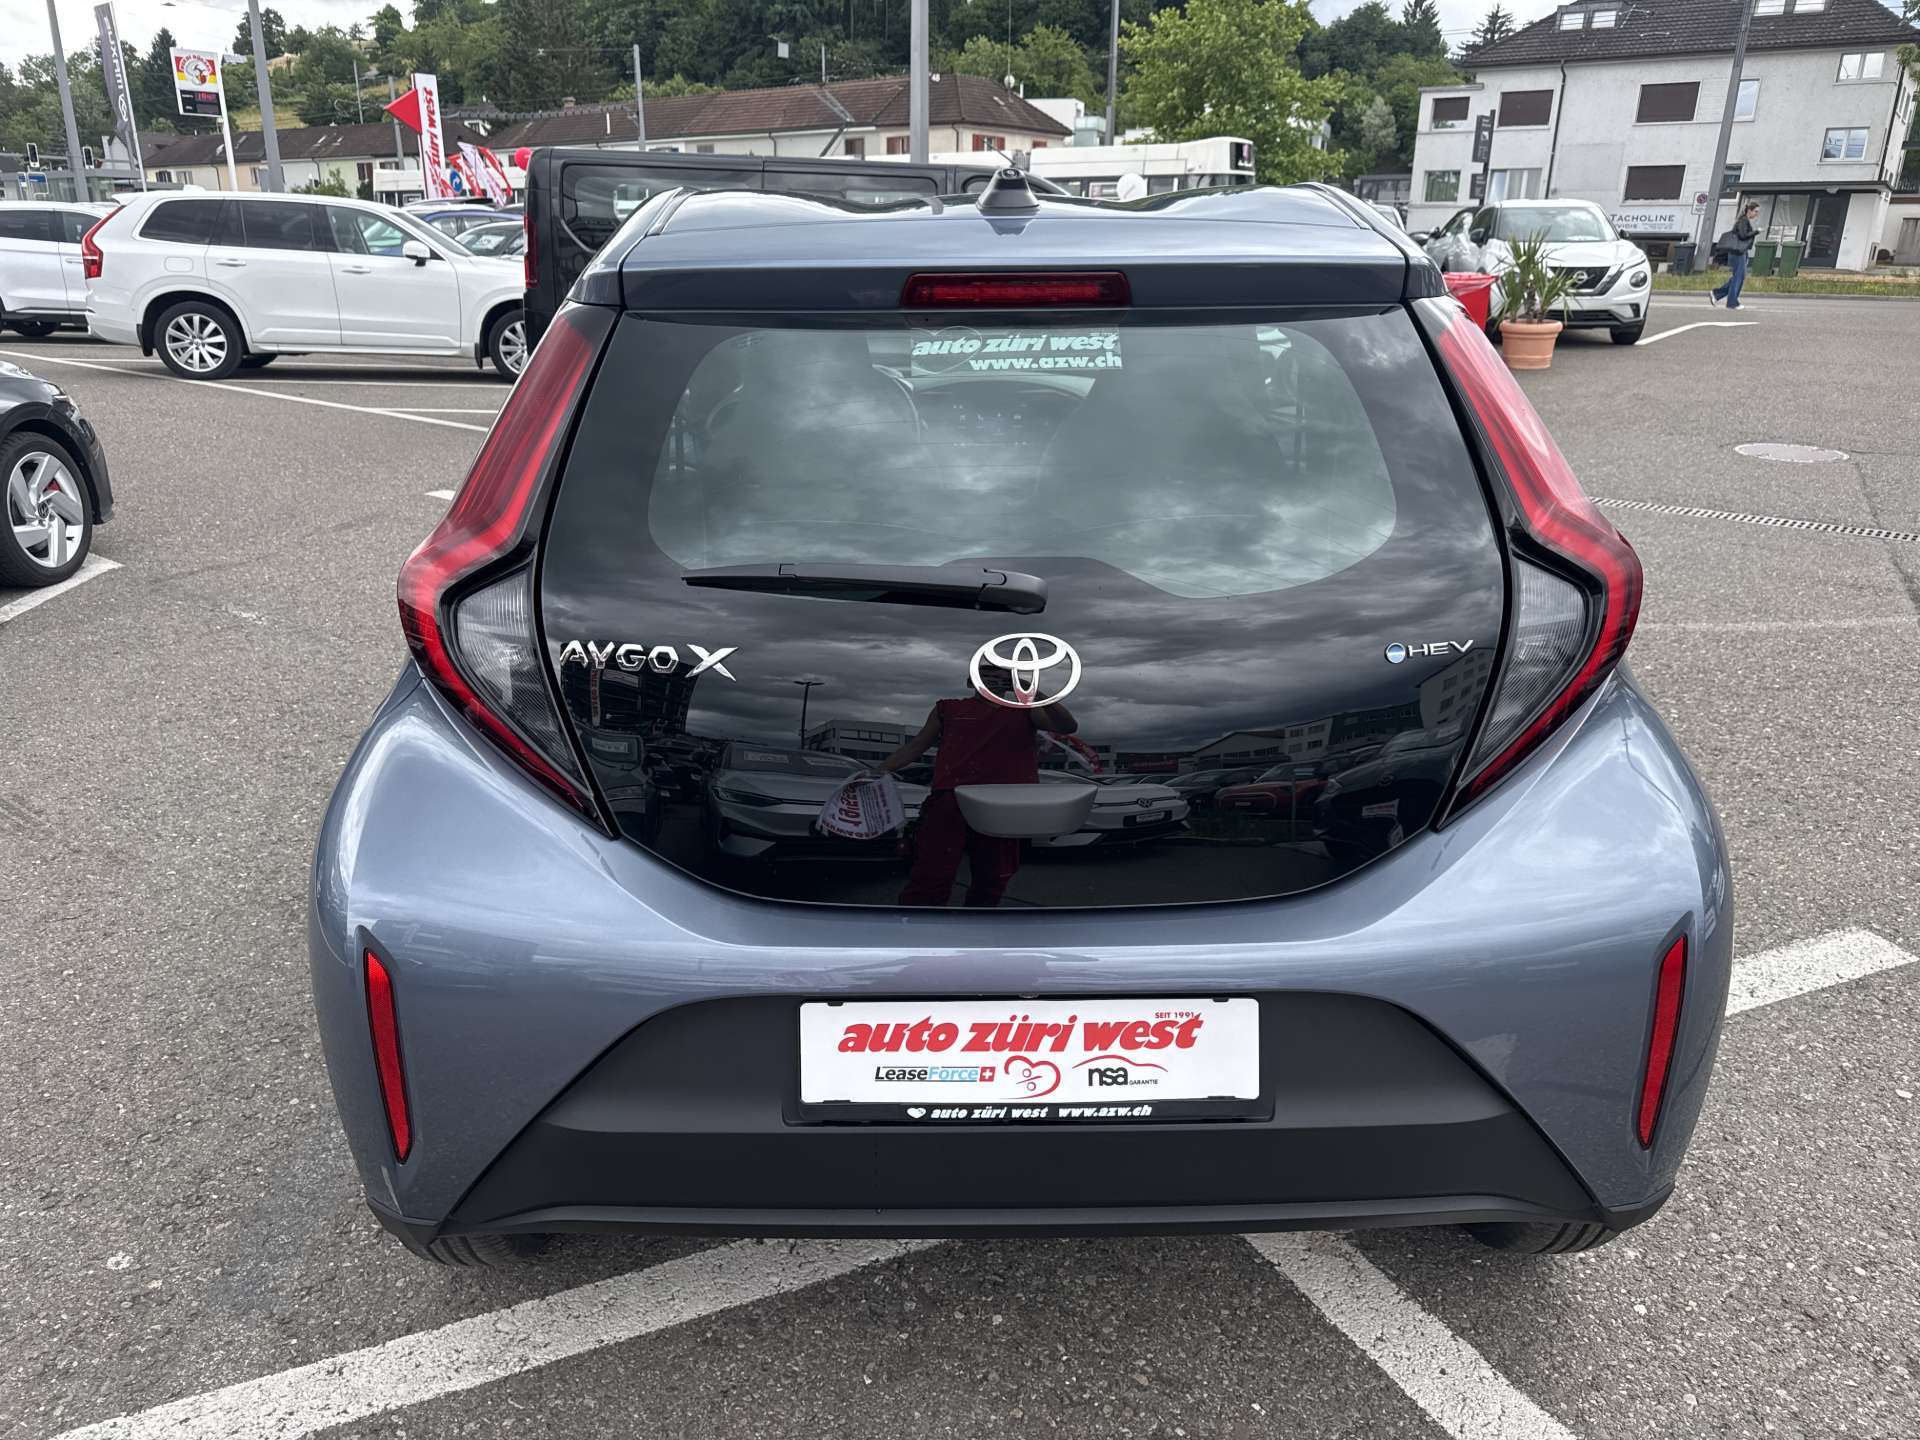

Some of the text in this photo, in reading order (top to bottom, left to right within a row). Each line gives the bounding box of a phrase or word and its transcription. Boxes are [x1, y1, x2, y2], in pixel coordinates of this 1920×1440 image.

[423, 87, 437, 128] west
[1610, 213, 1675, 223] TACHOLINE
[912, 334, 1119, 356] auto züri west
[969, 351, 1122, 371] www.azw.ch
[1408, 639, 1474, 658] HEV
[559, 639, 741, 682] AYGO X
[1174, 1011, 1195, 1019] 1991
[838, 1012, 1204, 1053] auto züri west
[874, 1066, 979, 1083] LeaseForce
[1088, 1066, 1129, 1087] nsa
[930, 1104, 1153, 1119] auto züri west www.azw.ch
